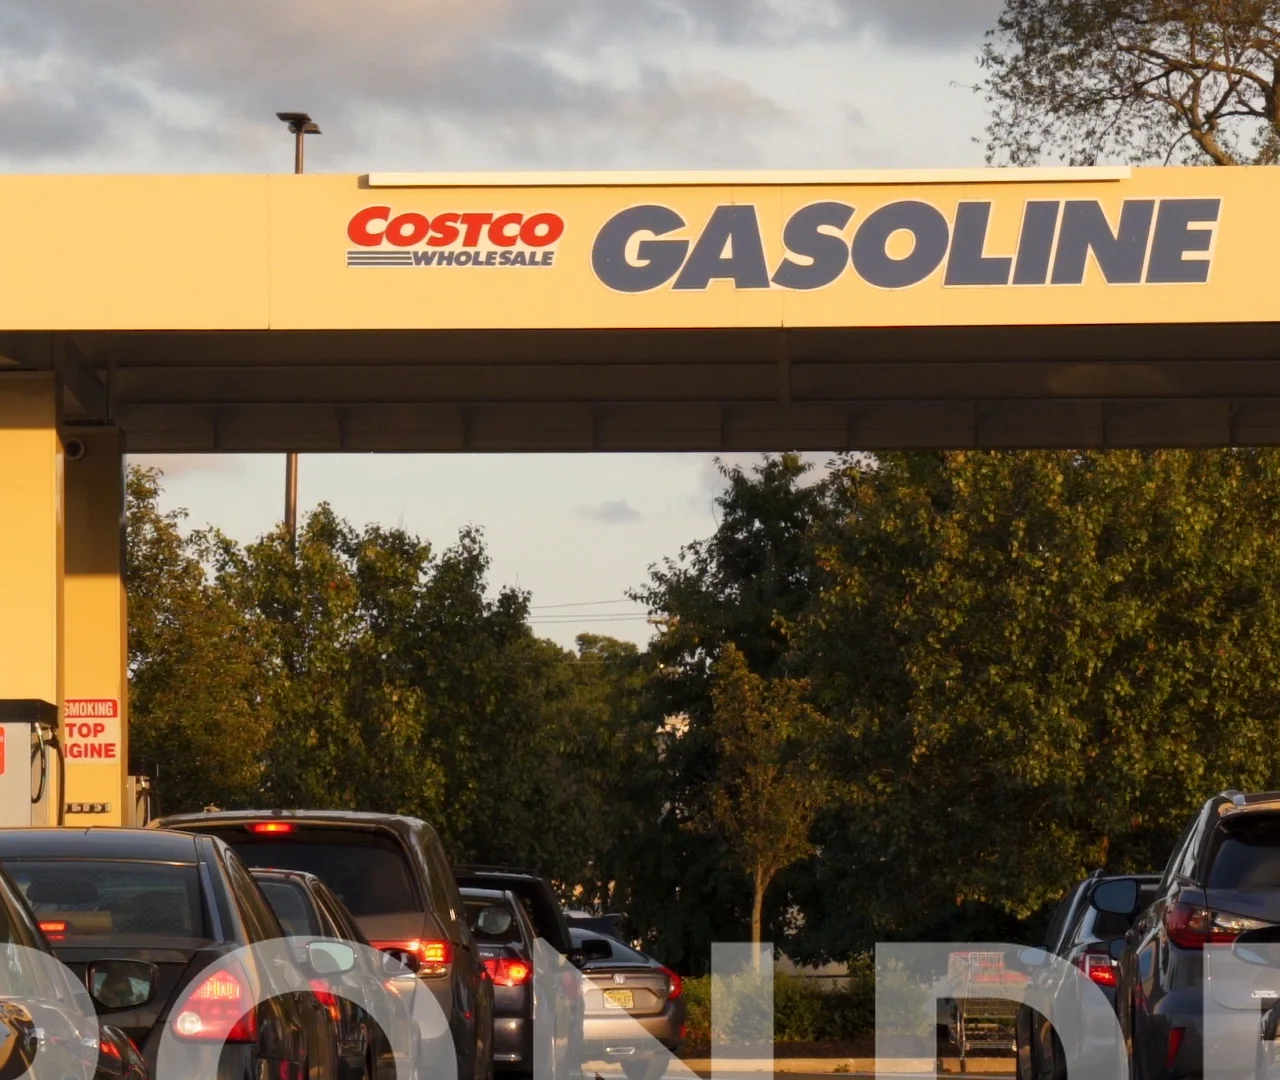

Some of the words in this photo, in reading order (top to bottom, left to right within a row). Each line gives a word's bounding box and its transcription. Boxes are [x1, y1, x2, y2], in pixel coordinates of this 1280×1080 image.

[347, 205, 565, 248] COSTCO
[591, 199, 1221, 292] GASOLINE
[411, 249, 555, 267] WHOLESALE
[65, 723, 105, 738] TOP
[64, 743, 116, 758] GINE
